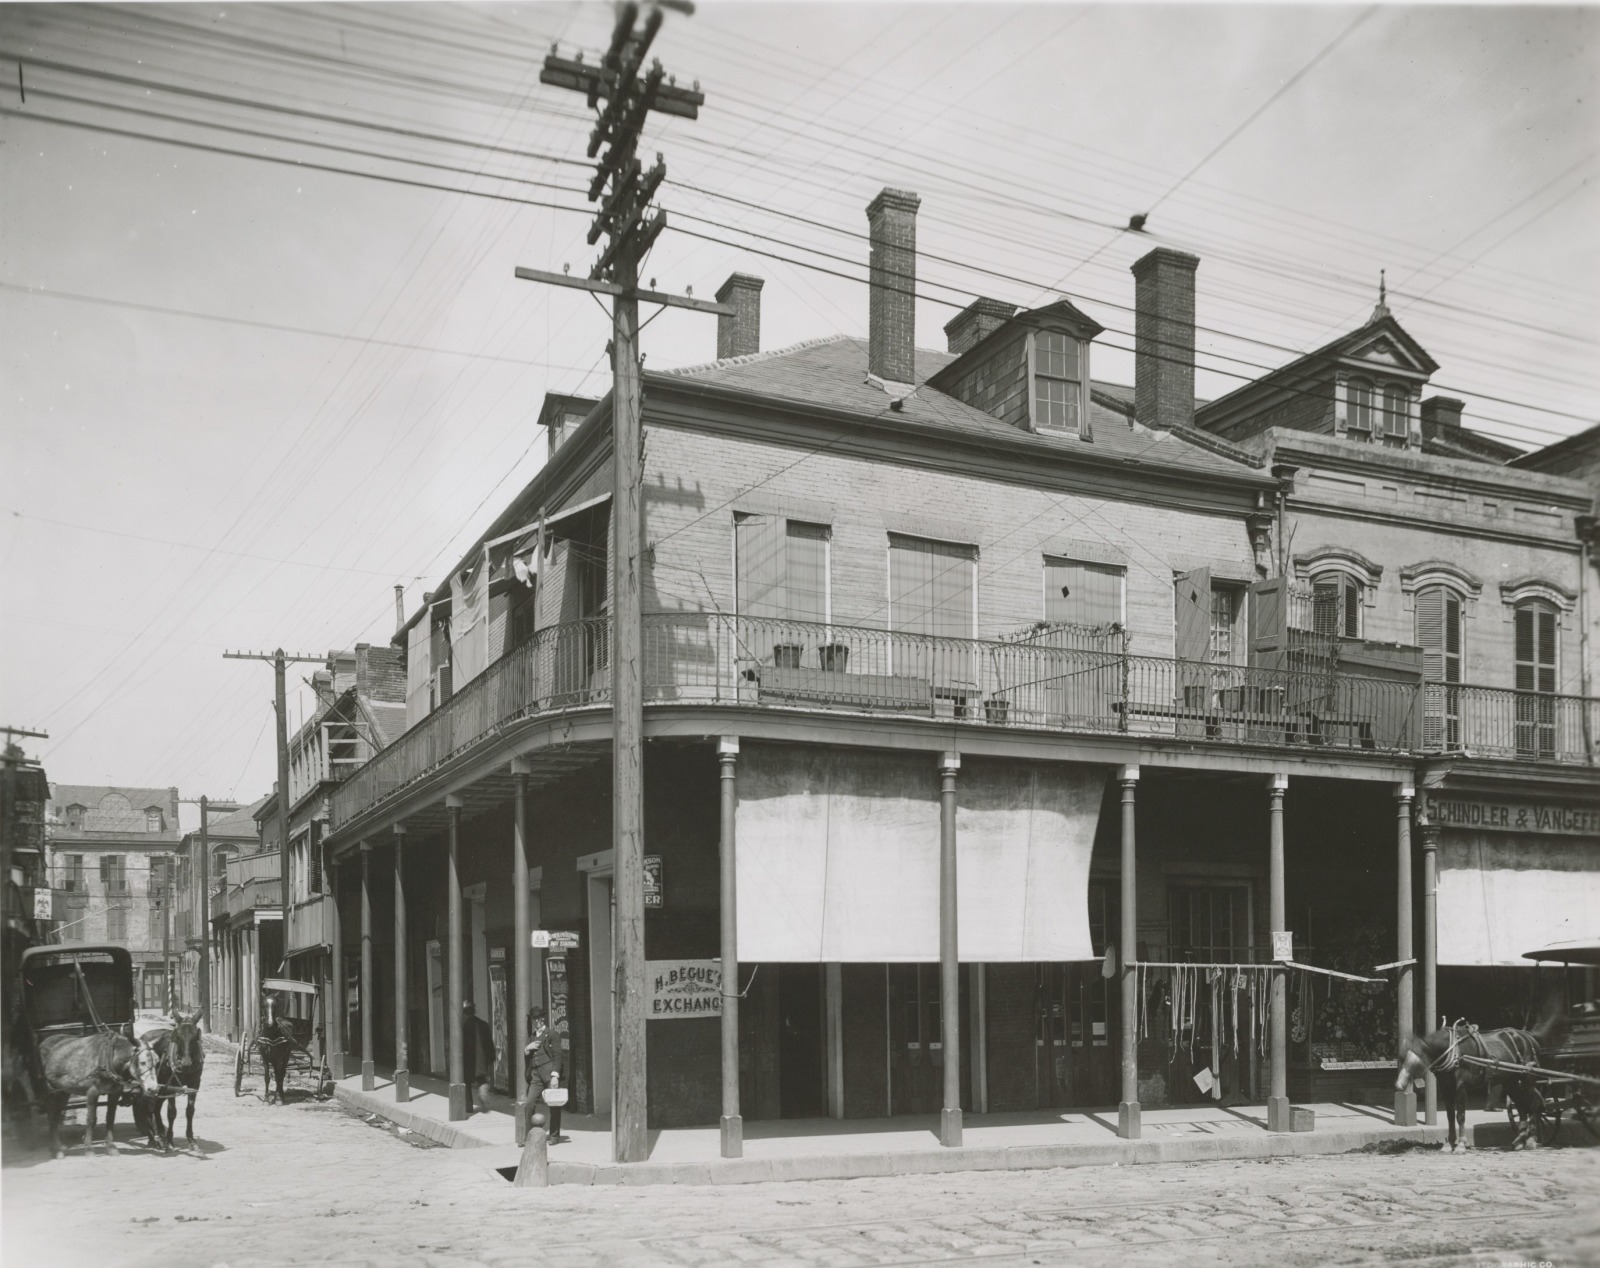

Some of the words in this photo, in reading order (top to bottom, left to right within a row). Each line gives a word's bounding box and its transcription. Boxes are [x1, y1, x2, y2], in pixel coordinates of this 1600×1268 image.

[1427, 797, 1509, 827] SCHINDLER
[1515, 808, 1528, 829] &
[643, 857, 661, 866] KSON
[645, 895, 661, 904] ER
[655, 975, 668, 994] H.
[652, 997, 722, 1013] EXCHANG
